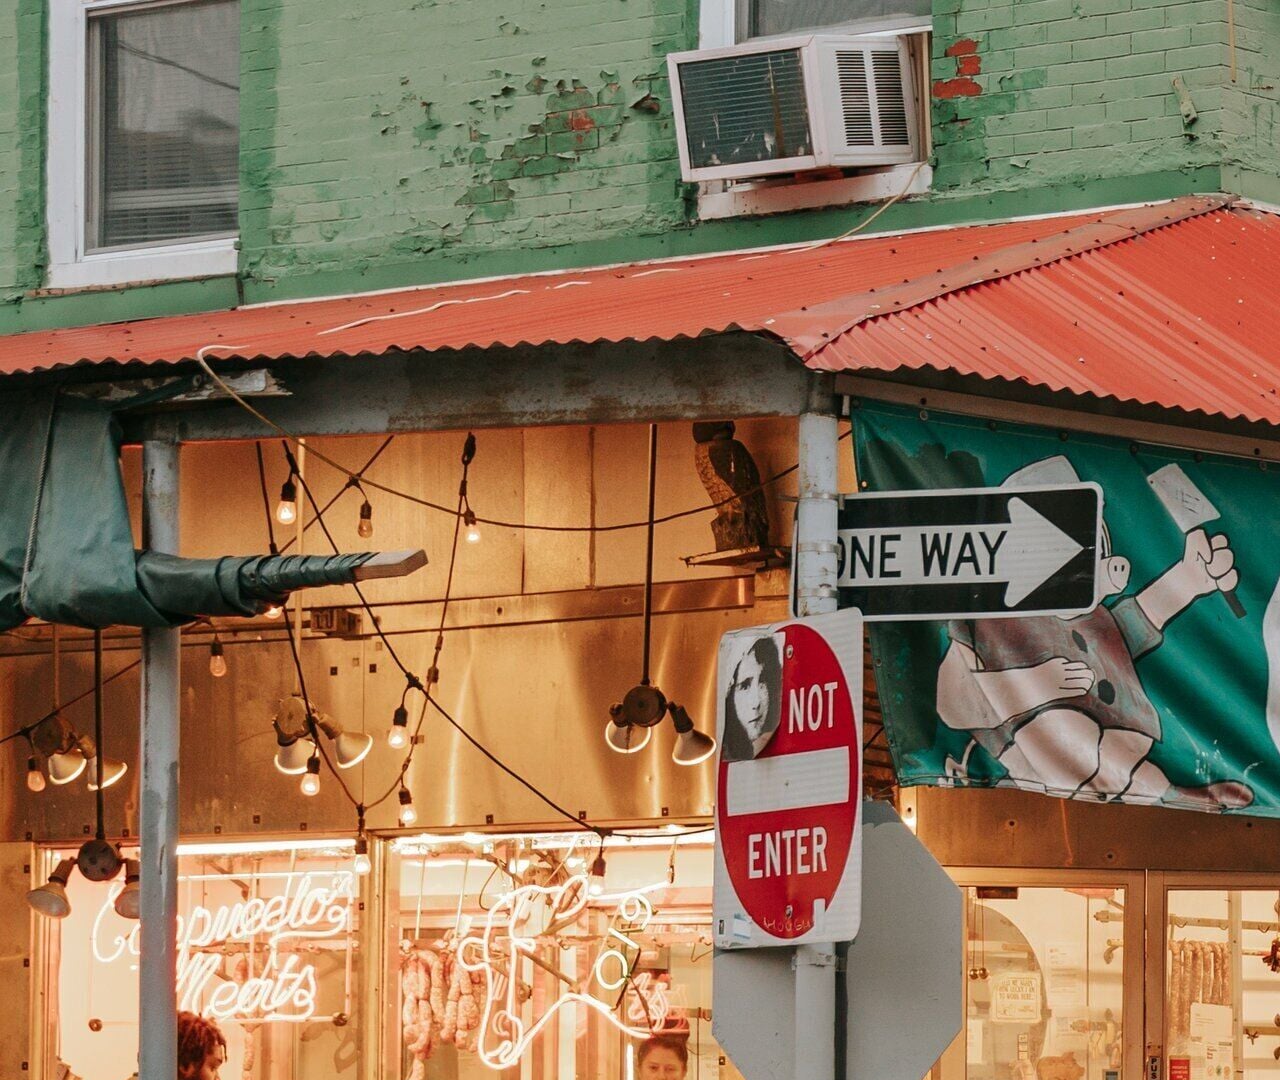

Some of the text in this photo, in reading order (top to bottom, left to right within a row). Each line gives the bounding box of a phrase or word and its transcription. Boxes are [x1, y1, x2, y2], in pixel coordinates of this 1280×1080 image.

[920, 530, 1008, 577] WAY
[788, 681, 838, 734] NOT
[748, 826, 828, 880] ENTER
